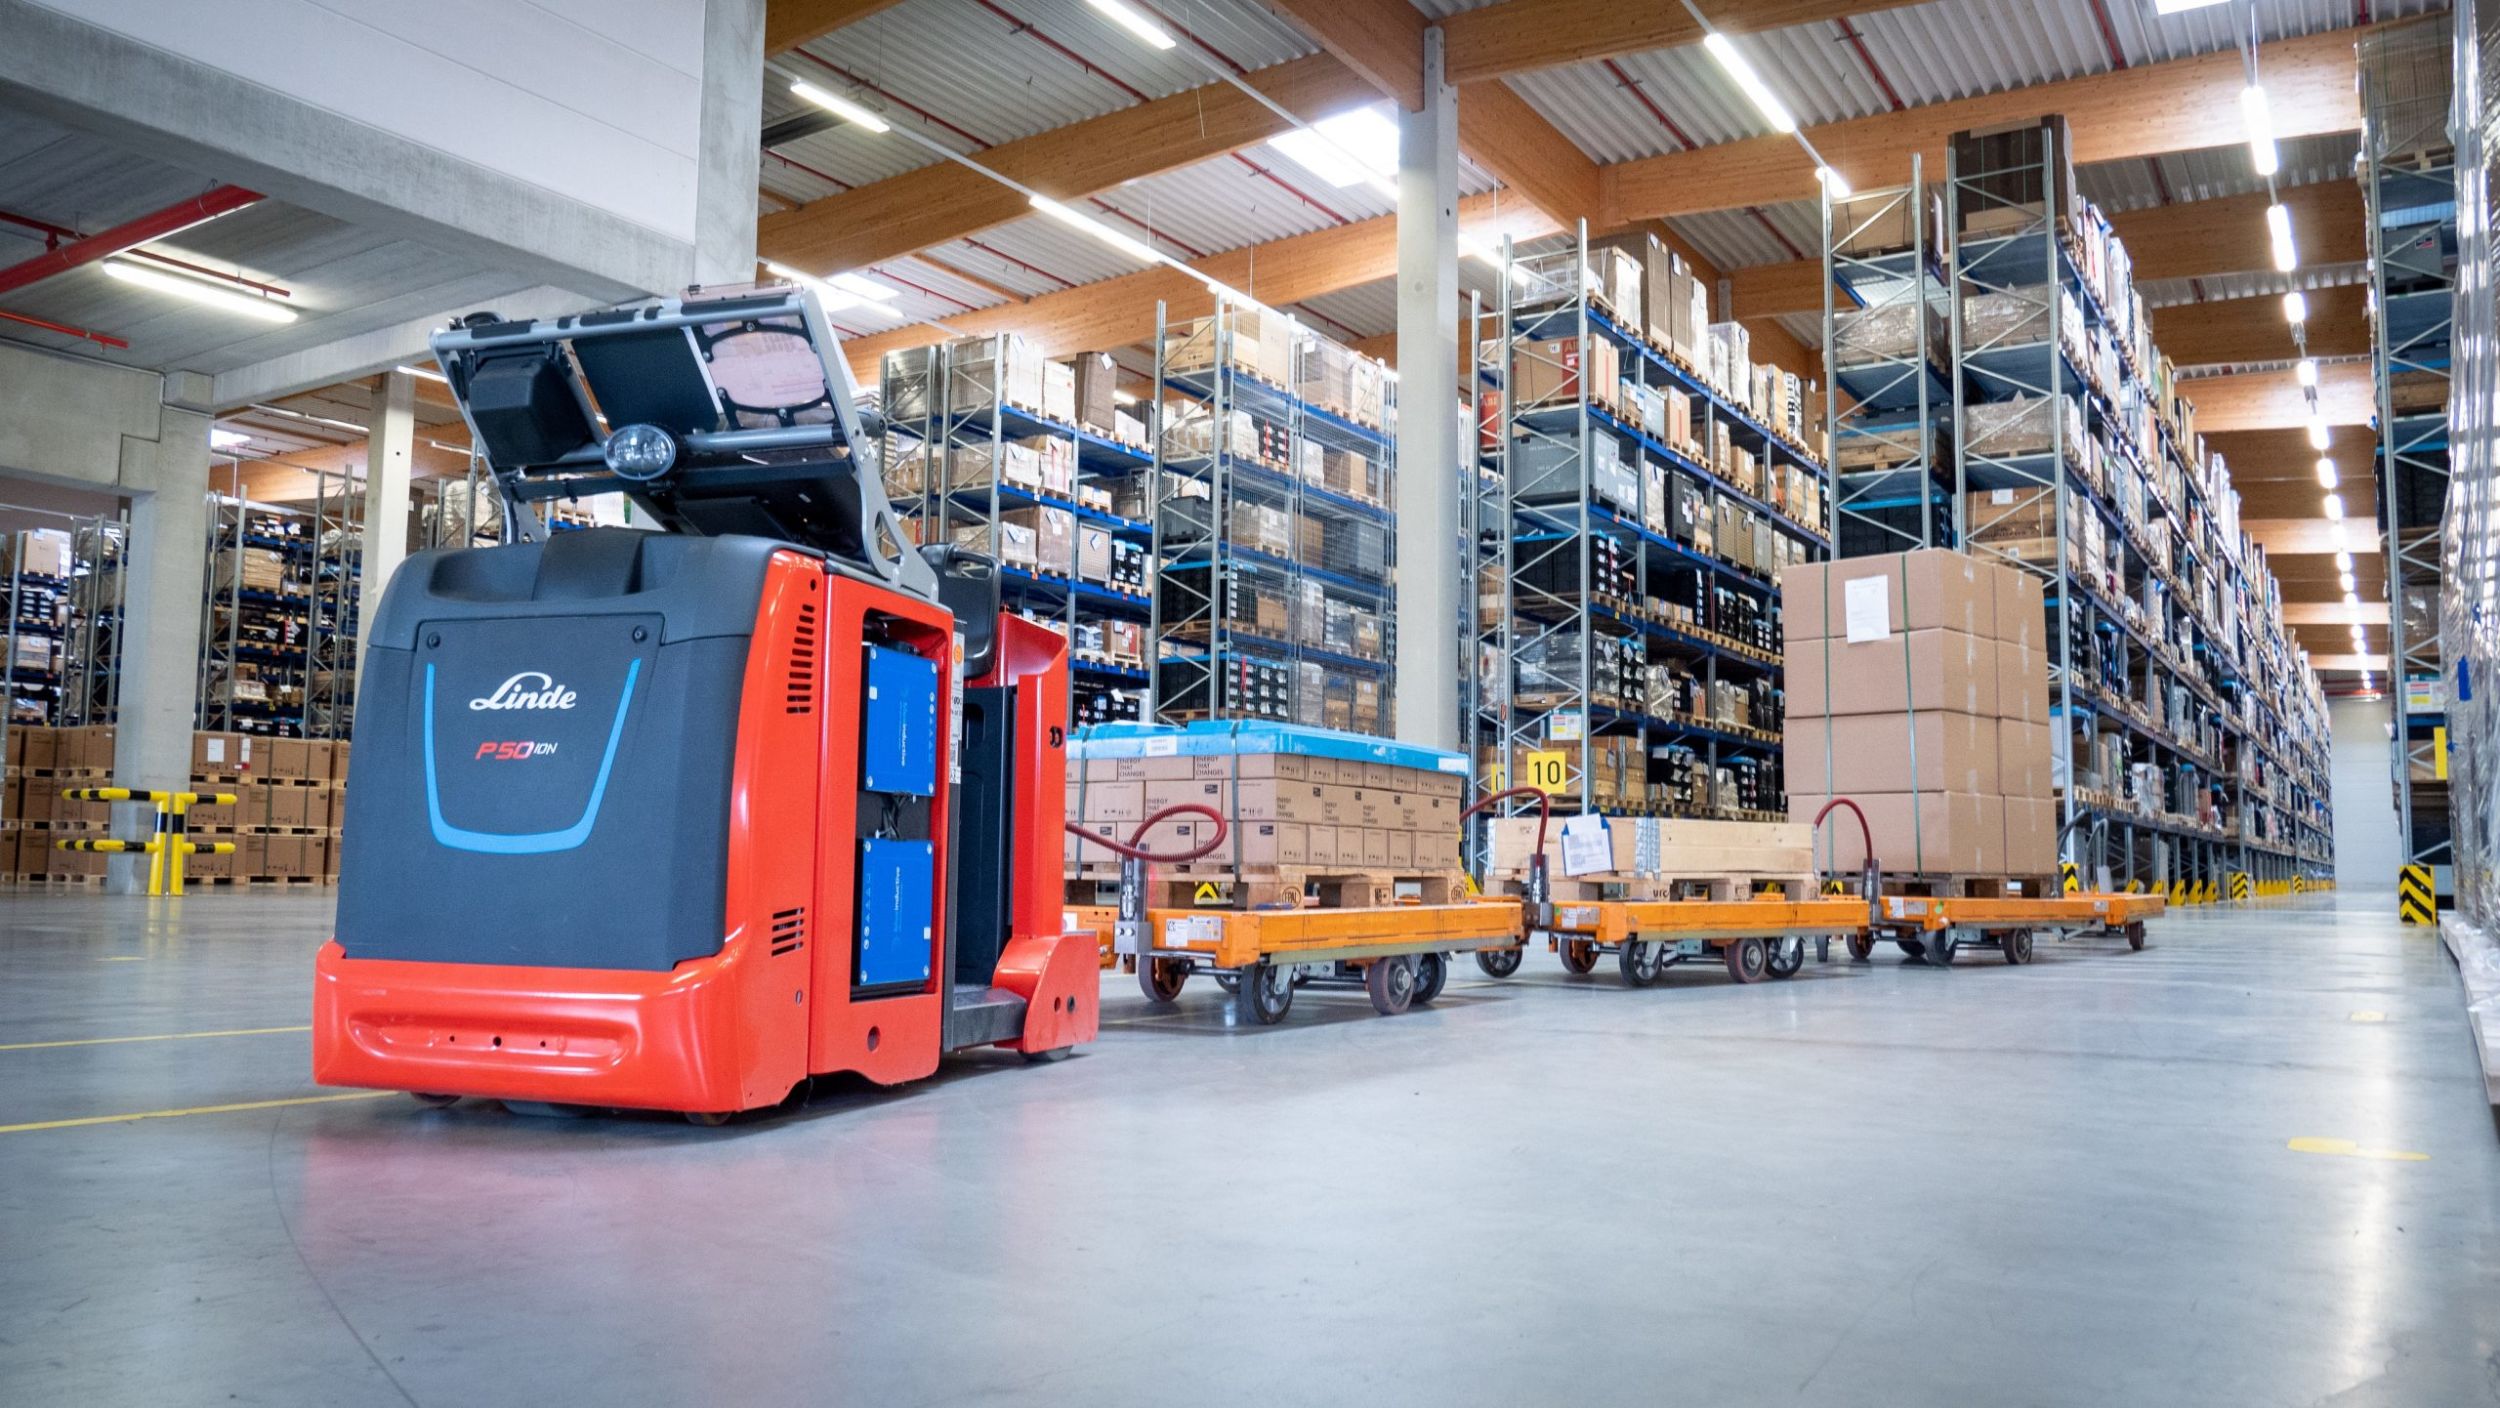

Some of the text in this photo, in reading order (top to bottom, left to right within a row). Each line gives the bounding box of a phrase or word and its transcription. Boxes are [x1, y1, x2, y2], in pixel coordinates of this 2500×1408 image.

[469, 671, 577, 710] Linde
[475, 741, 558, 760] P50 ION
[1534, 761, 1560, 785] 10
